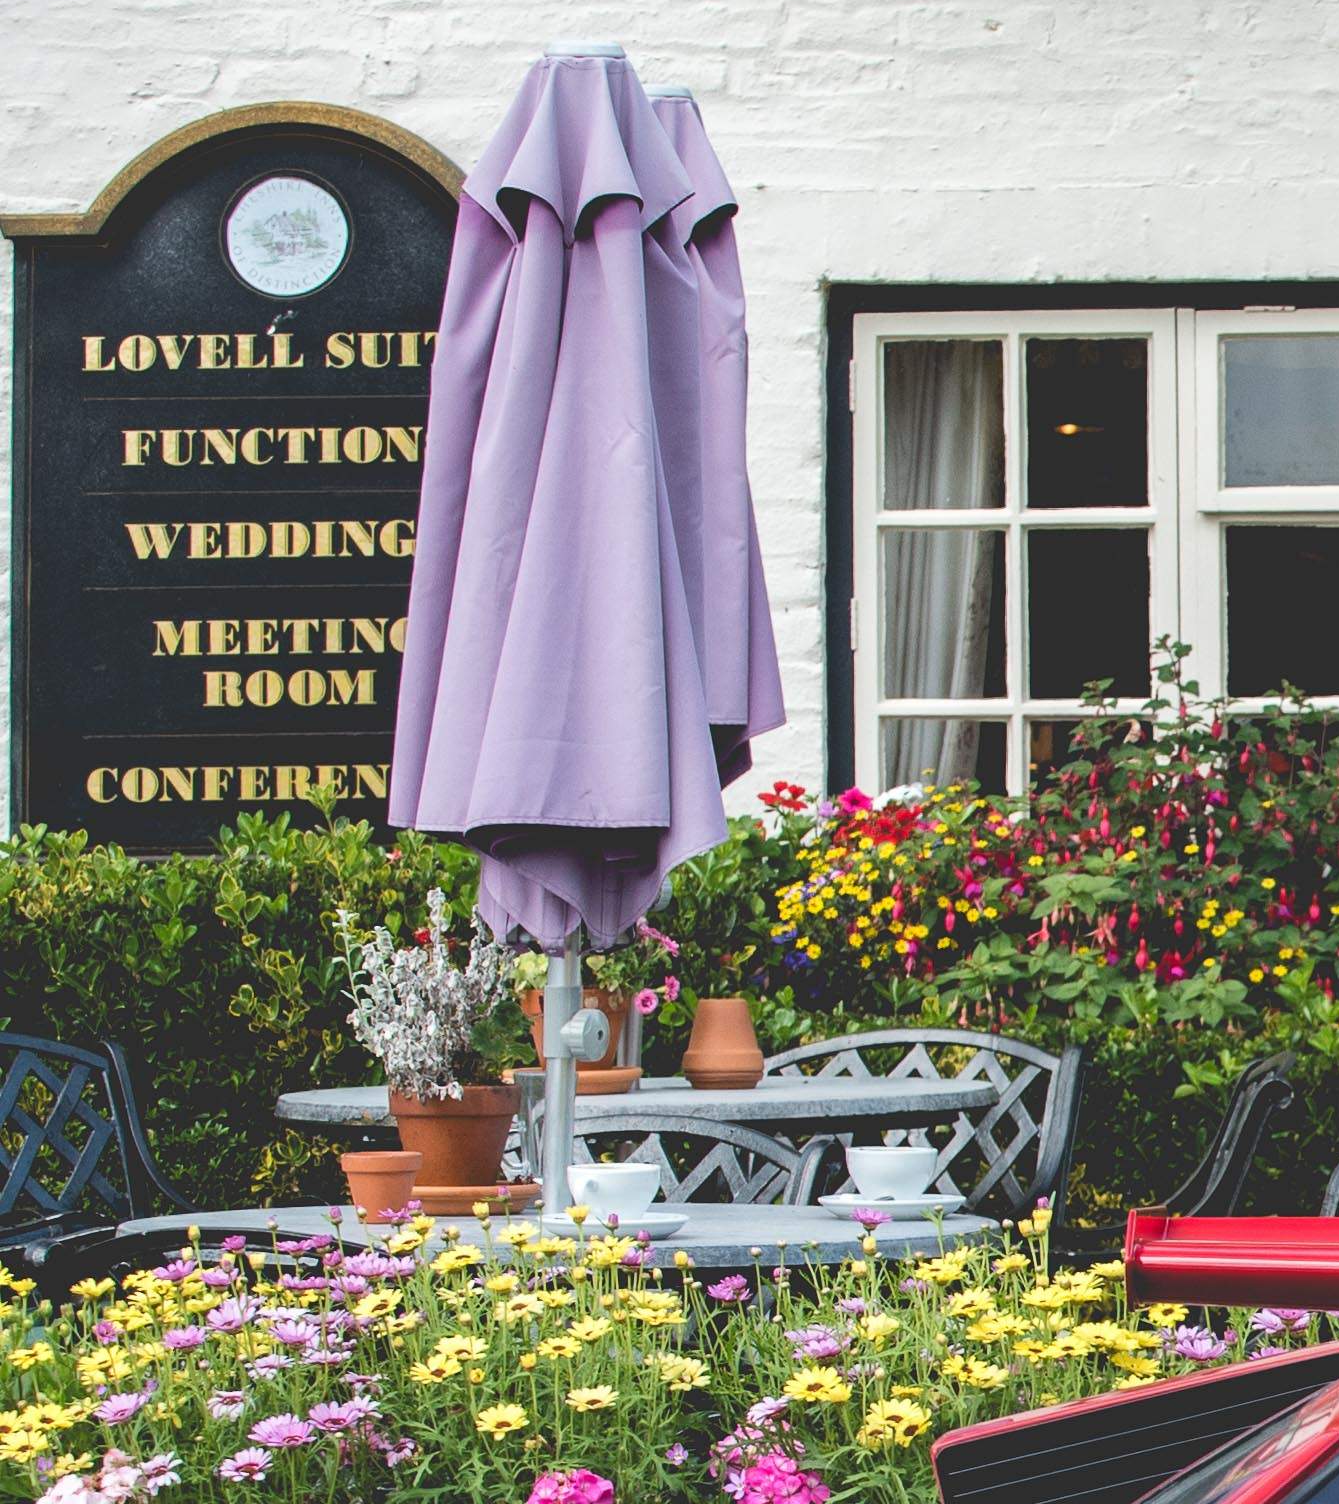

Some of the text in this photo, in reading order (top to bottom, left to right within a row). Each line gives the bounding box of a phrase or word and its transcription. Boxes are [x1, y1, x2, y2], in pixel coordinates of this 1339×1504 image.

[247, 249, 342, 290] DISTINCTION
[82, 334, 304, 372] LOVELL
[123, 426, 423, 466] FUNCTION
[125, 519, 415, 560] WEDDING
[203, 669, 377, 707] ROOM
